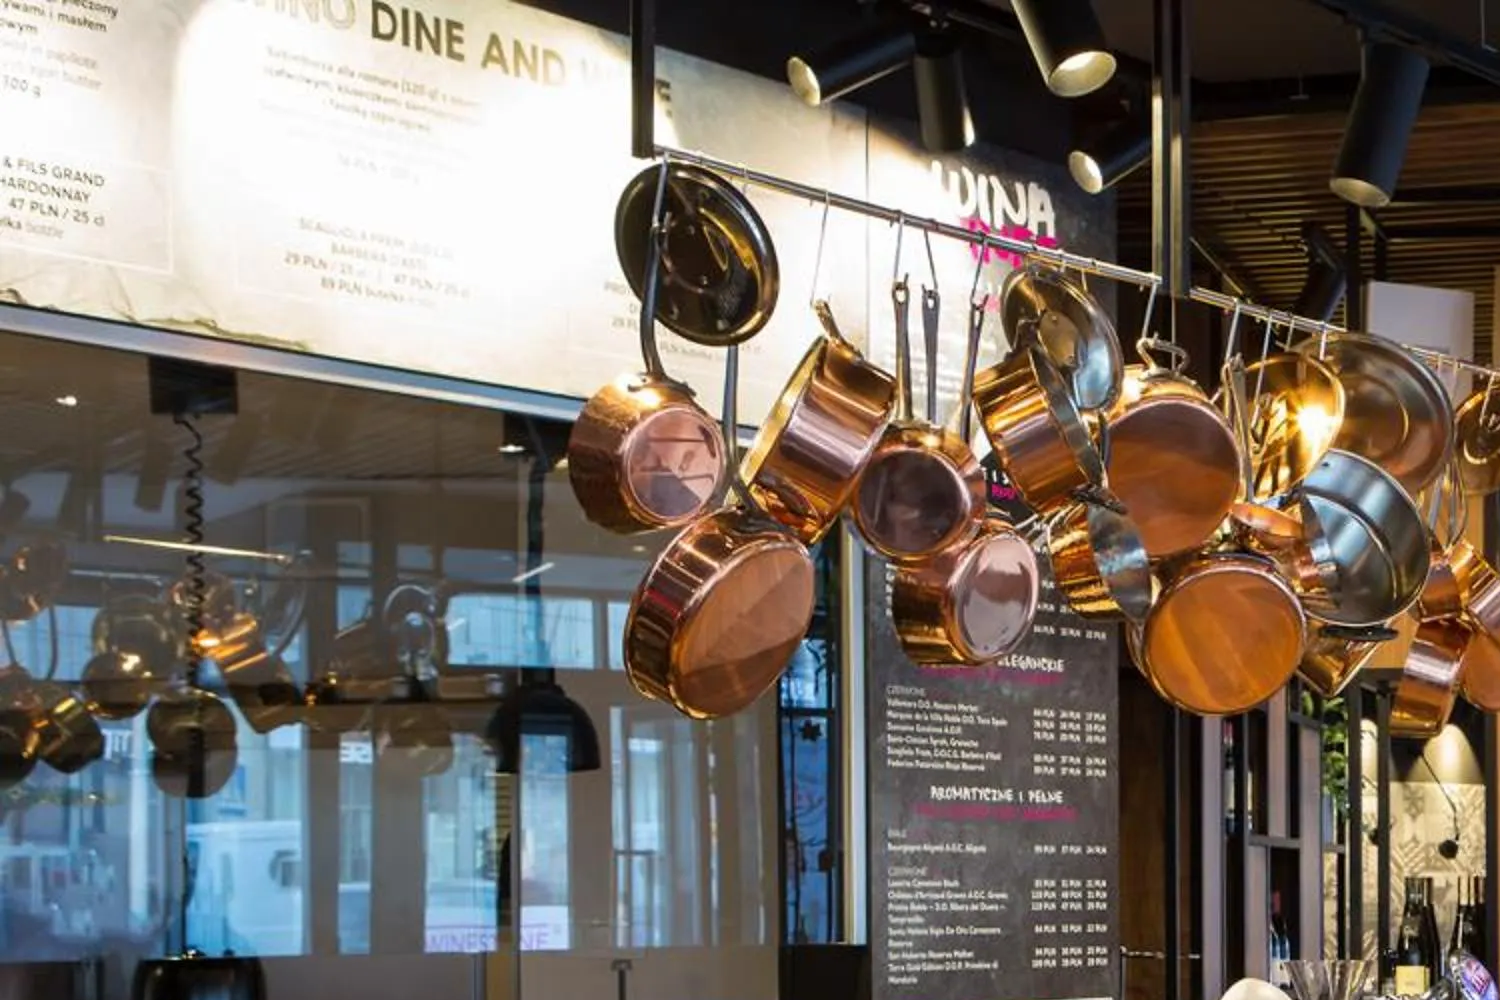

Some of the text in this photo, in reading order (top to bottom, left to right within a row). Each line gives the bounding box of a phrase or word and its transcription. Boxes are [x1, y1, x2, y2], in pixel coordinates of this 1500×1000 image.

[371, 1, 466, 62] DINE
[481, 32, 566, 87] AND
[17, 157, 48, 175] FILS
[51, 165, 105, 188] GRAND
[8, 197, 26, 210] 47
[30, 200, 59, 218] PLN
